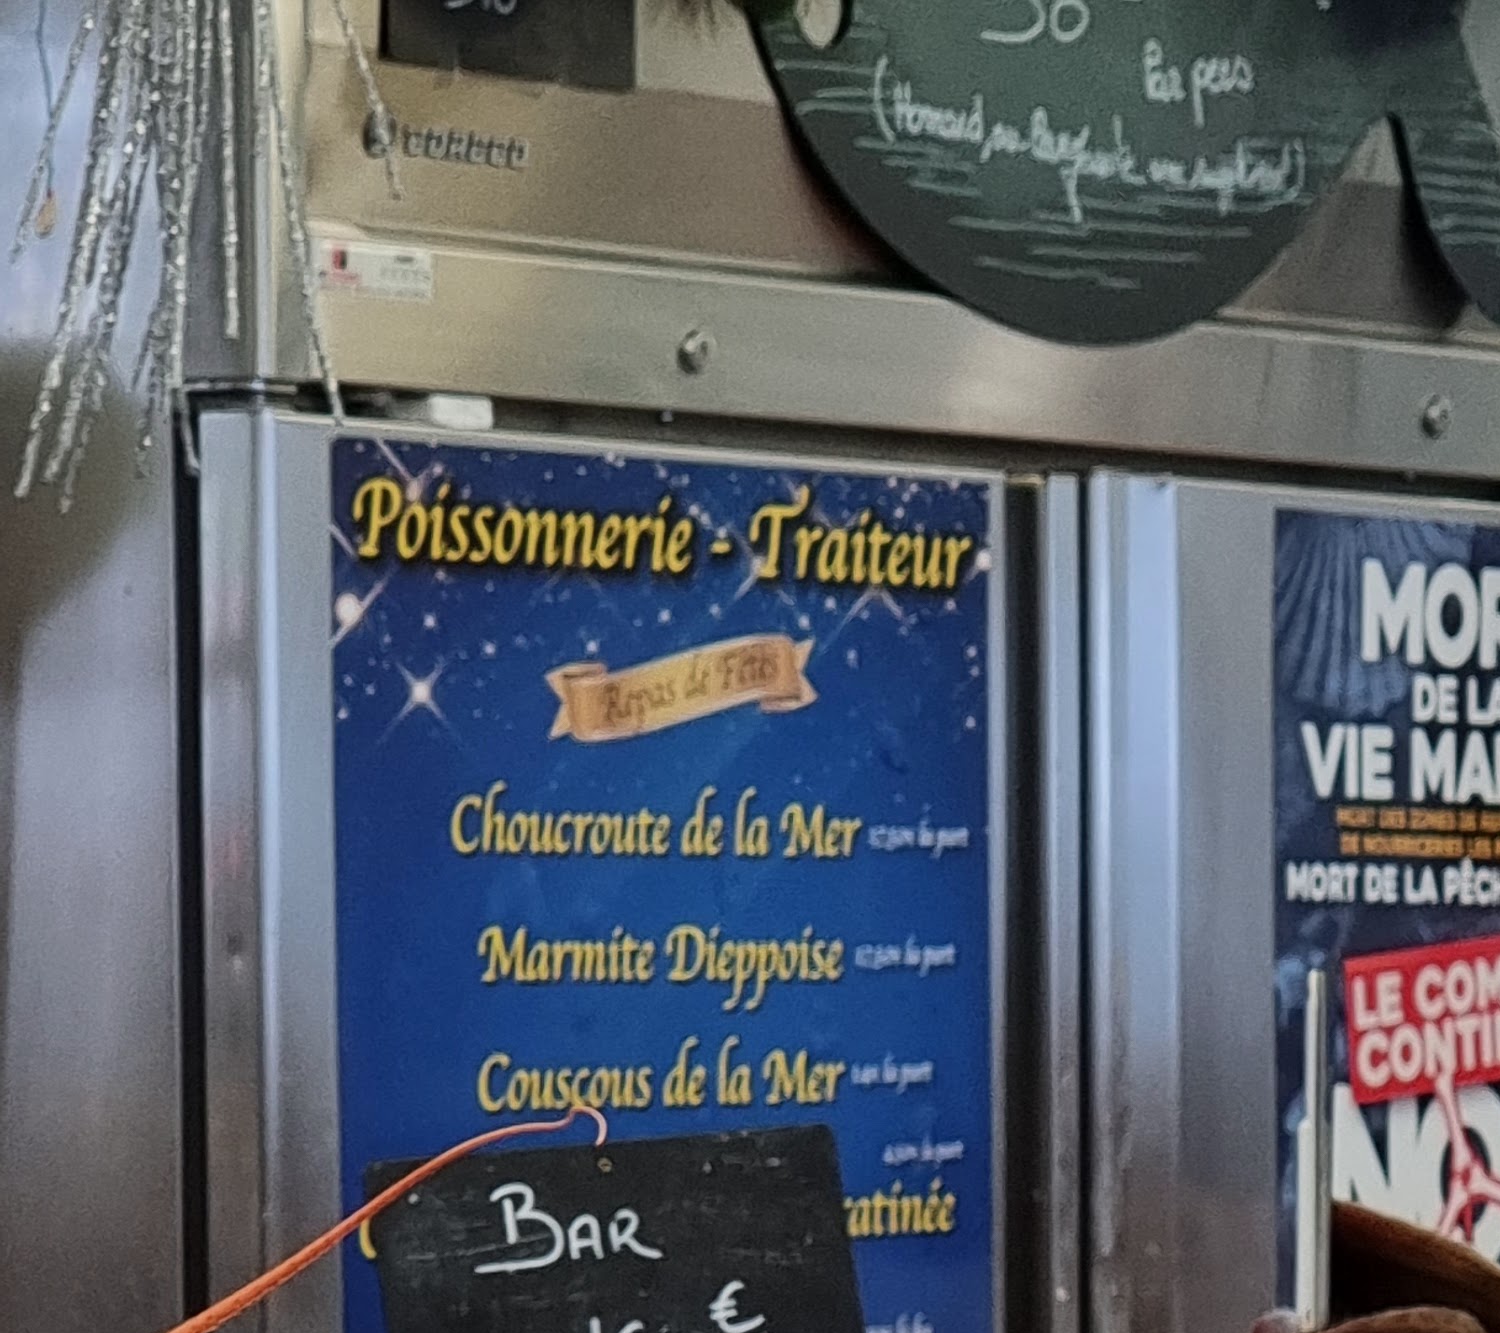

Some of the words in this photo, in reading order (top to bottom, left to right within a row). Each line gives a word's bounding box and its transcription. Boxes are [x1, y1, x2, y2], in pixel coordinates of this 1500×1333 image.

[352, 476, 694, 574] Poissonnerie
[749, 483, 974, 590] Traiteur
[1411, 673, 1459, 724] DE
[1301, 721, 1395, 801] VIE
[449, 781, 670, 858] Choucroute
[681, 785, 723, 857] de
[733, 786, 772, 857] la
[779, 803, 862, 858] Mer
[1286, 861, 1359, 902] MORT
[1362, 863, 1398, 904] DE
[1403, 865, 1438, 905] LA
[476, 925, 655, 984] Marmite
[664, 923, 846, 1010] Dieppoise
[1351, 969, 1403, 1032] LE
[476, 1052, 653, 1114] Couscous
[662, 1035, 706, 1107] de
[717, 1035, 753, 1107] la
[761, 1048, 847, 1106] Mer
[474, 1181, 663, 1275] BAR
[843, 1179, 958, 1238] atinée
